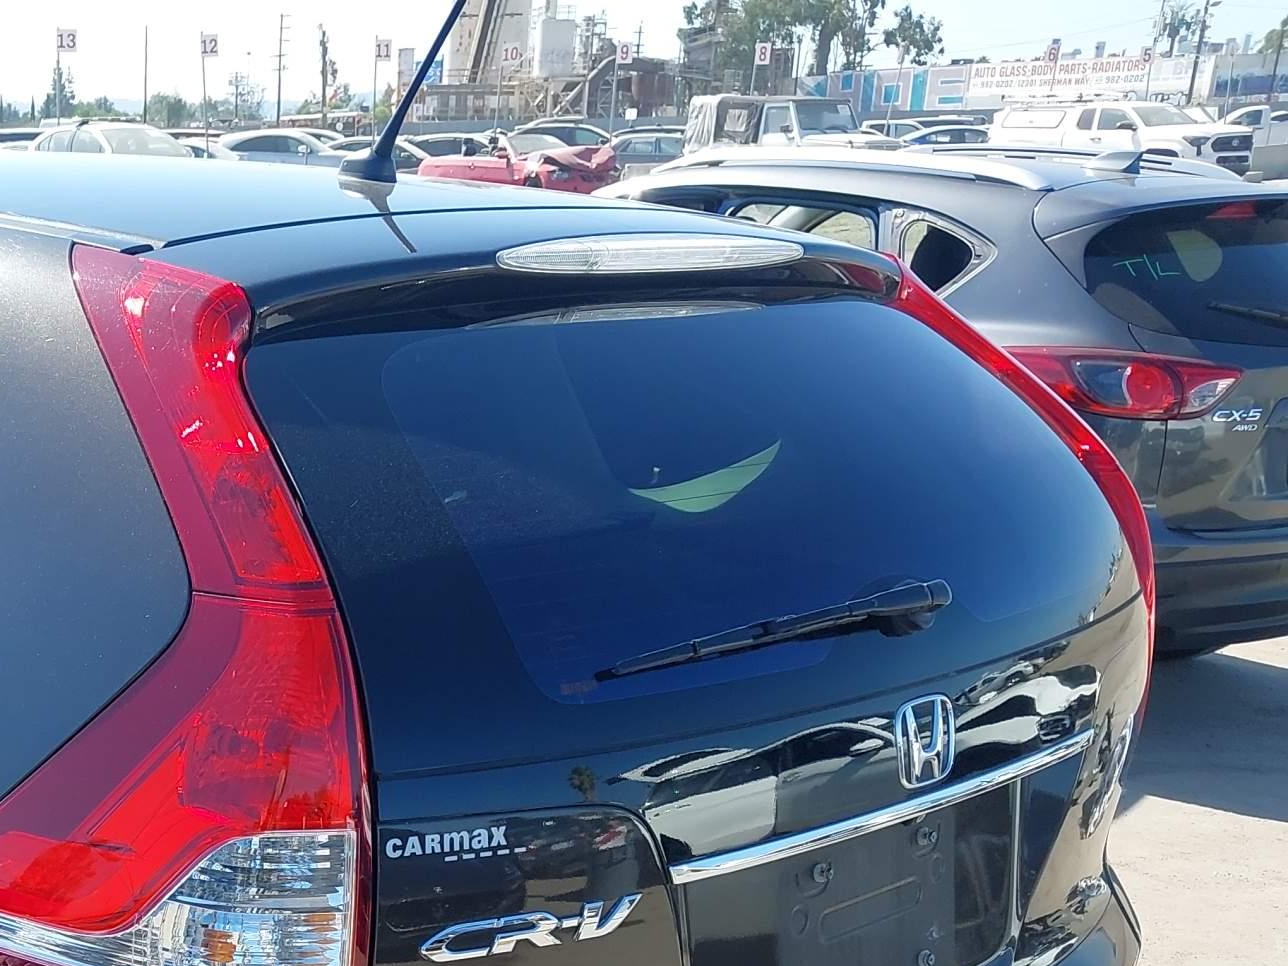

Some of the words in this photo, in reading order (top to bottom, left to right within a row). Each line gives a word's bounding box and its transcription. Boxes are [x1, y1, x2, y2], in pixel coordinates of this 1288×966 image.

[57, 33, 76, 49] 13
[202, 38, 217, 54] 12
[376, 43, 390, 57] 11
[503, 47, 519, 61] 10
[620, 44, 629, 60] 9
[759, 46, 768, 62] 8
[1048, 47, 1057, 61] 6
[1143, 48, 1152, 63] 5
[974, 67, 996, 78] AUTO
[1212, 409, 1263, 421] CX-5
[1231, 424, 1258, 432] AWD
[420, 893, 643, 963] CR-V
